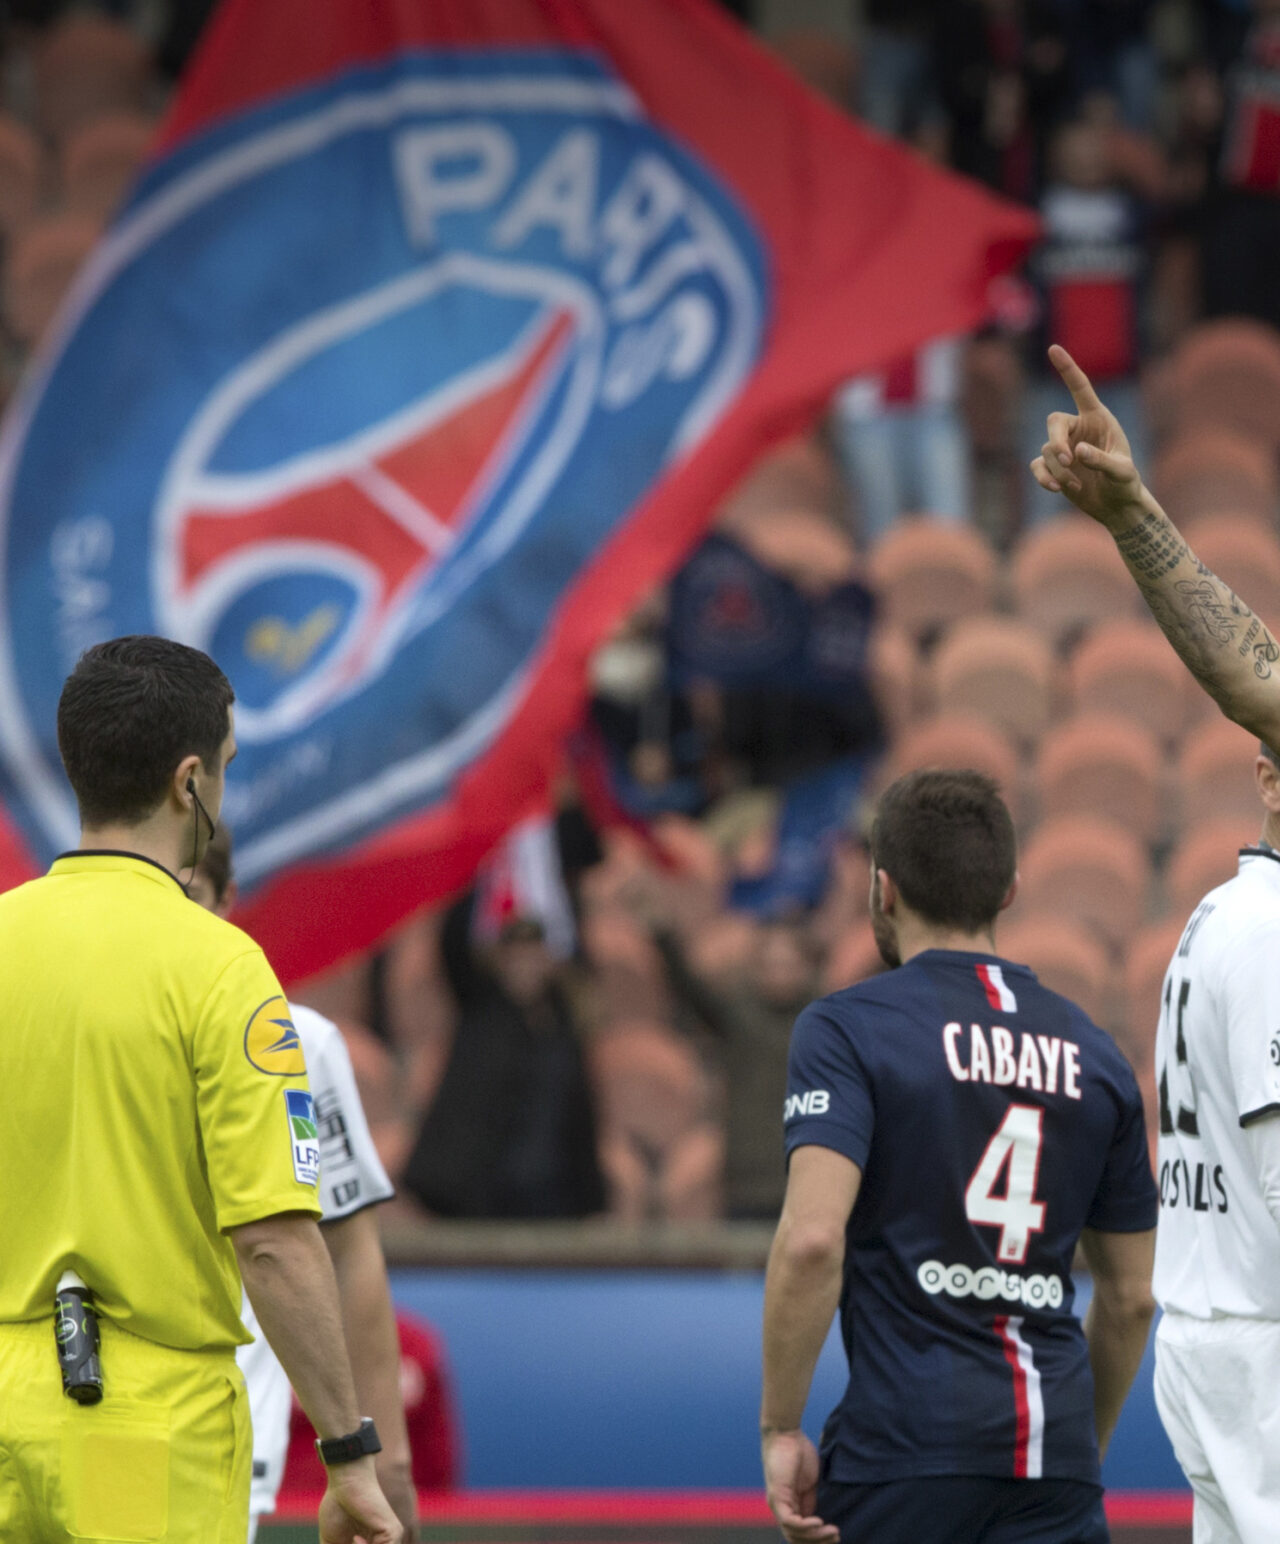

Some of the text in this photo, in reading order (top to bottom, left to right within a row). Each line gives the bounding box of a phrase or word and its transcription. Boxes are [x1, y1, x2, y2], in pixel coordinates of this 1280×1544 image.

[391, 119, 717, 412] PARIS
[943, 1021, 1082, 1100] CABAYE
[965, 1102, 1047, 1265] 4
